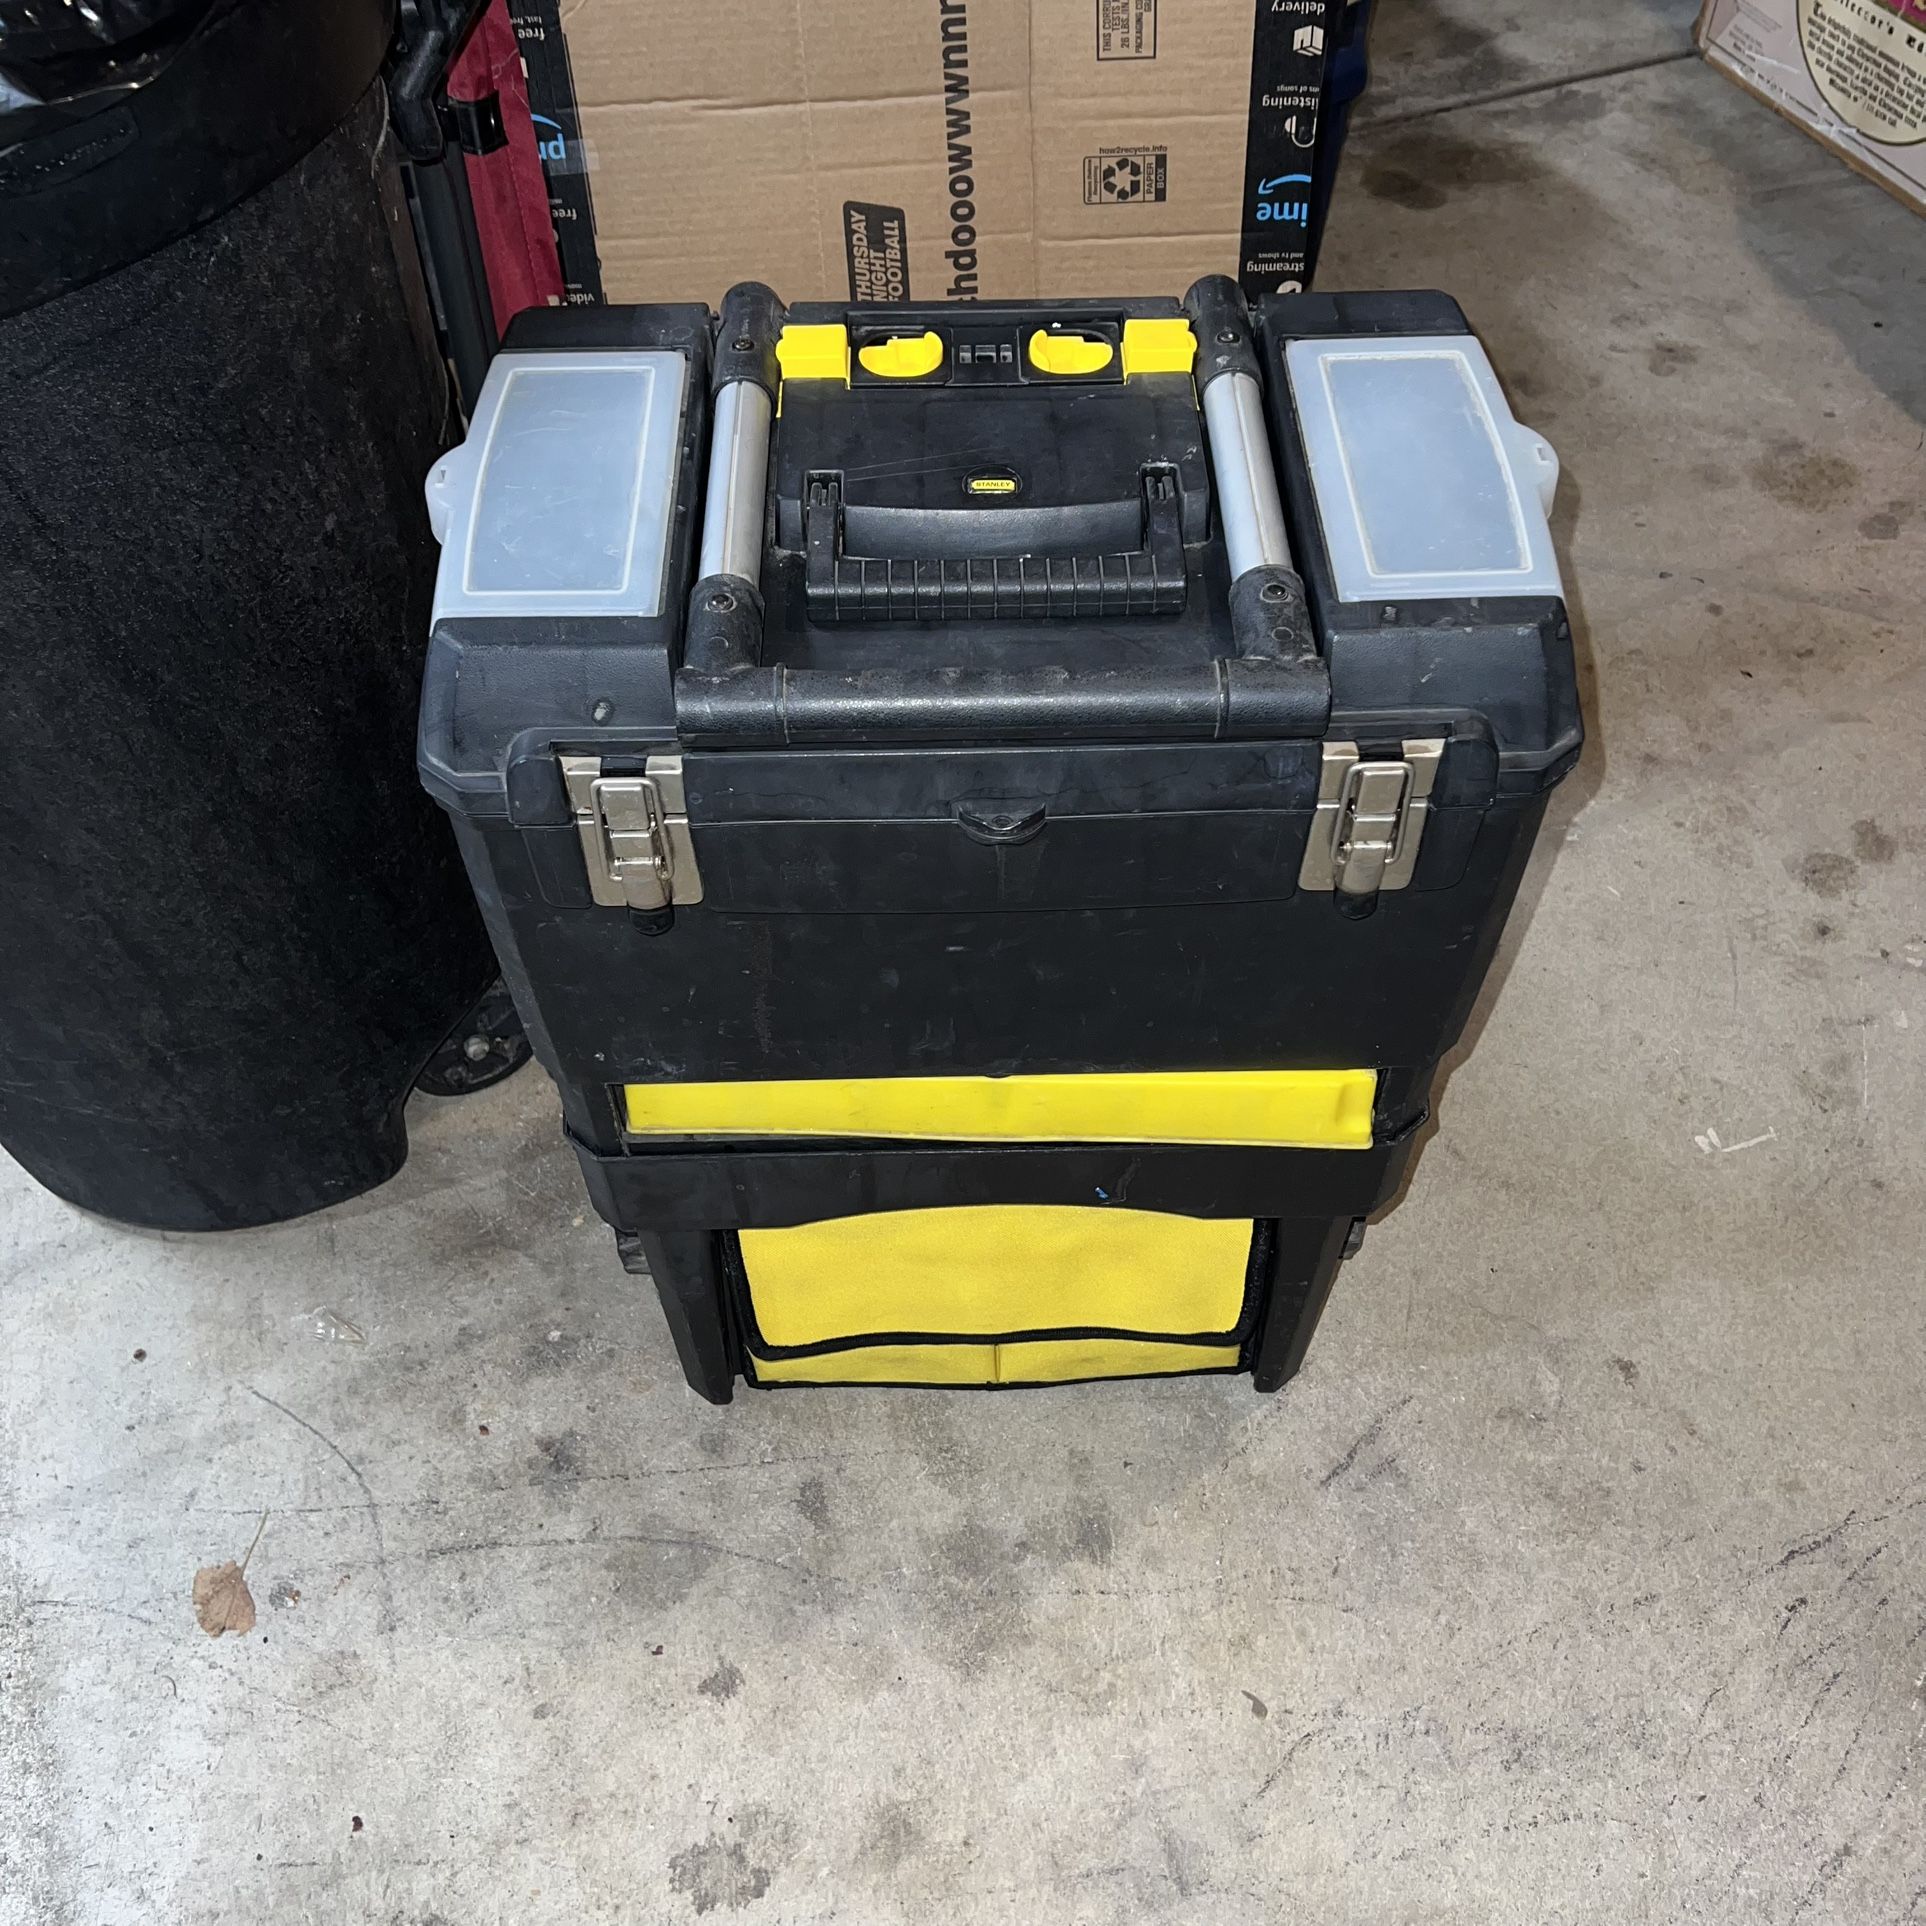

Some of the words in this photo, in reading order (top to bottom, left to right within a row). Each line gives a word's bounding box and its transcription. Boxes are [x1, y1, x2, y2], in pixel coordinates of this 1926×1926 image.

[1271, 0, 1326, 16] delivery
[1111, 5, 1120, 32] TESTS
[518, 27, 545, 41] free
[1102, 32, 1112, 52] THIS
[1120, 37, 1130, 49] 26
[1261, 94, 1319, 111] listening
[1145, 162, 1154, 194] PAPER
[1156, 167, 1165, 189] BOX
[552, 208, 577, 220] free
[1255, 202, 1308, 227] ime
[851, 209, 872, 303] THURSDAY
[883, 219, 904, 303] FOOTBALL
[869, 249, 887, 303] NIGHT
[1246, 260, 1305, 275] streaming
[565, 293, 595, 305] vide
